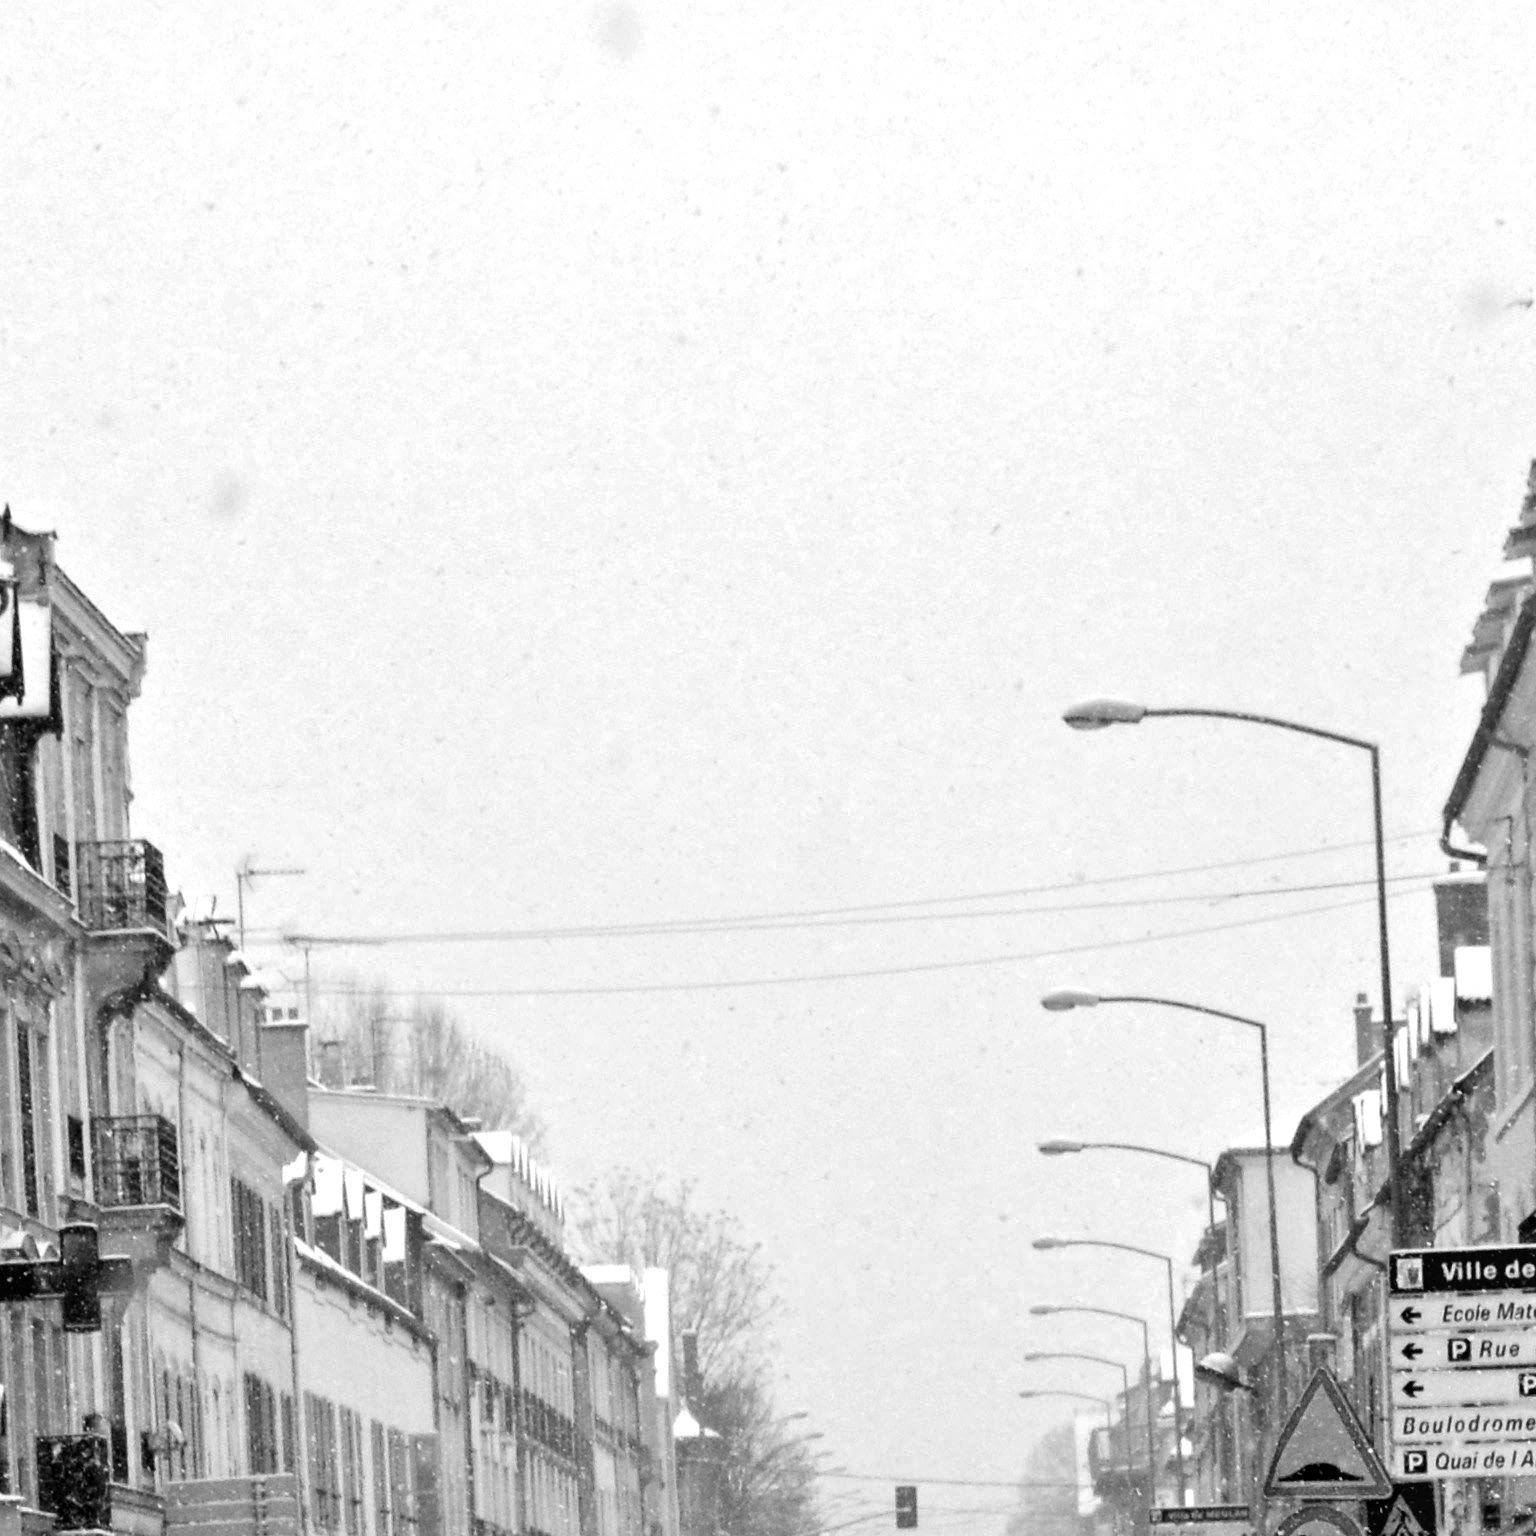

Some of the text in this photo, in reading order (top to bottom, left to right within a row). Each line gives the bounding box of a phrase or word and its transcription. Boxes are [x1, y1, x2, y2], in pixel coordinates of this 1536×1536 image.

[1441, 1259, 1497, 1281] Ville
[1505, 1256, 1536, 1278] de
[1442, 1304, 1491, 1323] Ecole
[1478, 1340, 1519, 1359] Rue
[1402, 1413, 1536, 1435] Boulodrome
[1435, 1452, 1478, 1471] Quai
[1483, 1451, 1506, 1470] de
